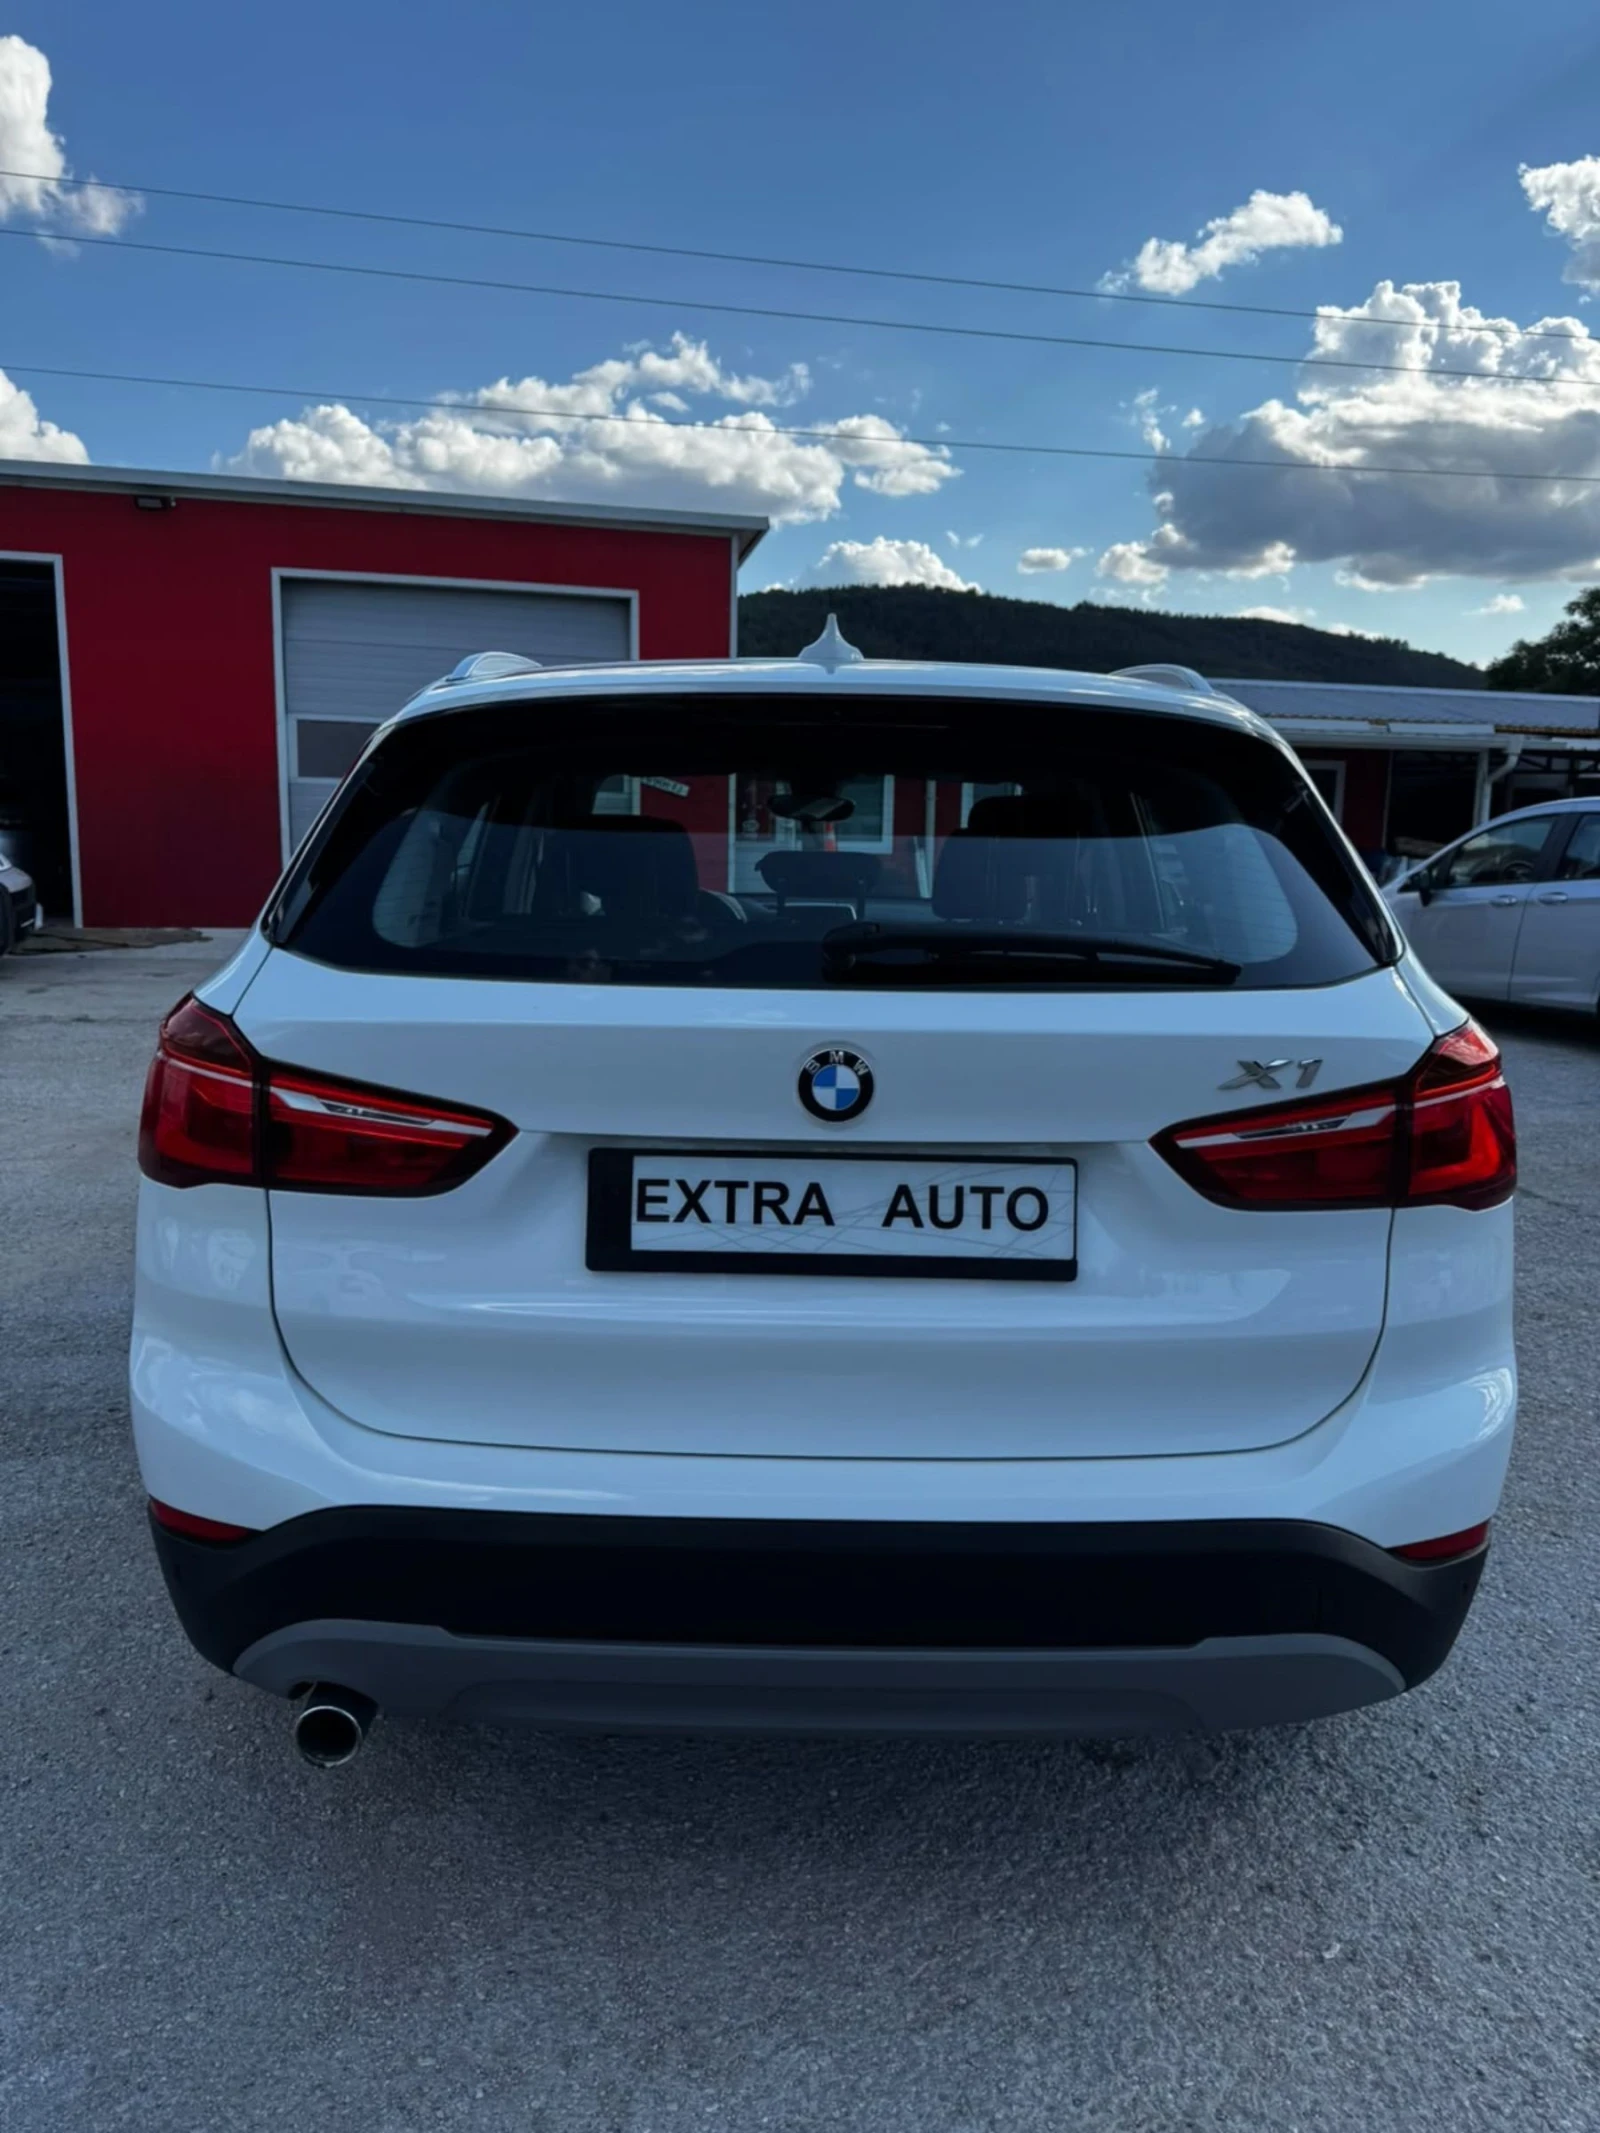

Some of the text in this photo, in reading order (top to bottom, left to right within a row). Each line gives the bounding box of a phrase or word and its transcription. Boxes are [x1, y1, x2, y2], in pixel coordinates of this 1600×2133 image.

[804, 1050, 869, 1076] BMW
[1217, 1058, 1323, 1090] X1
[636, 1178, 1050, 1231] EXTRA AUTO
